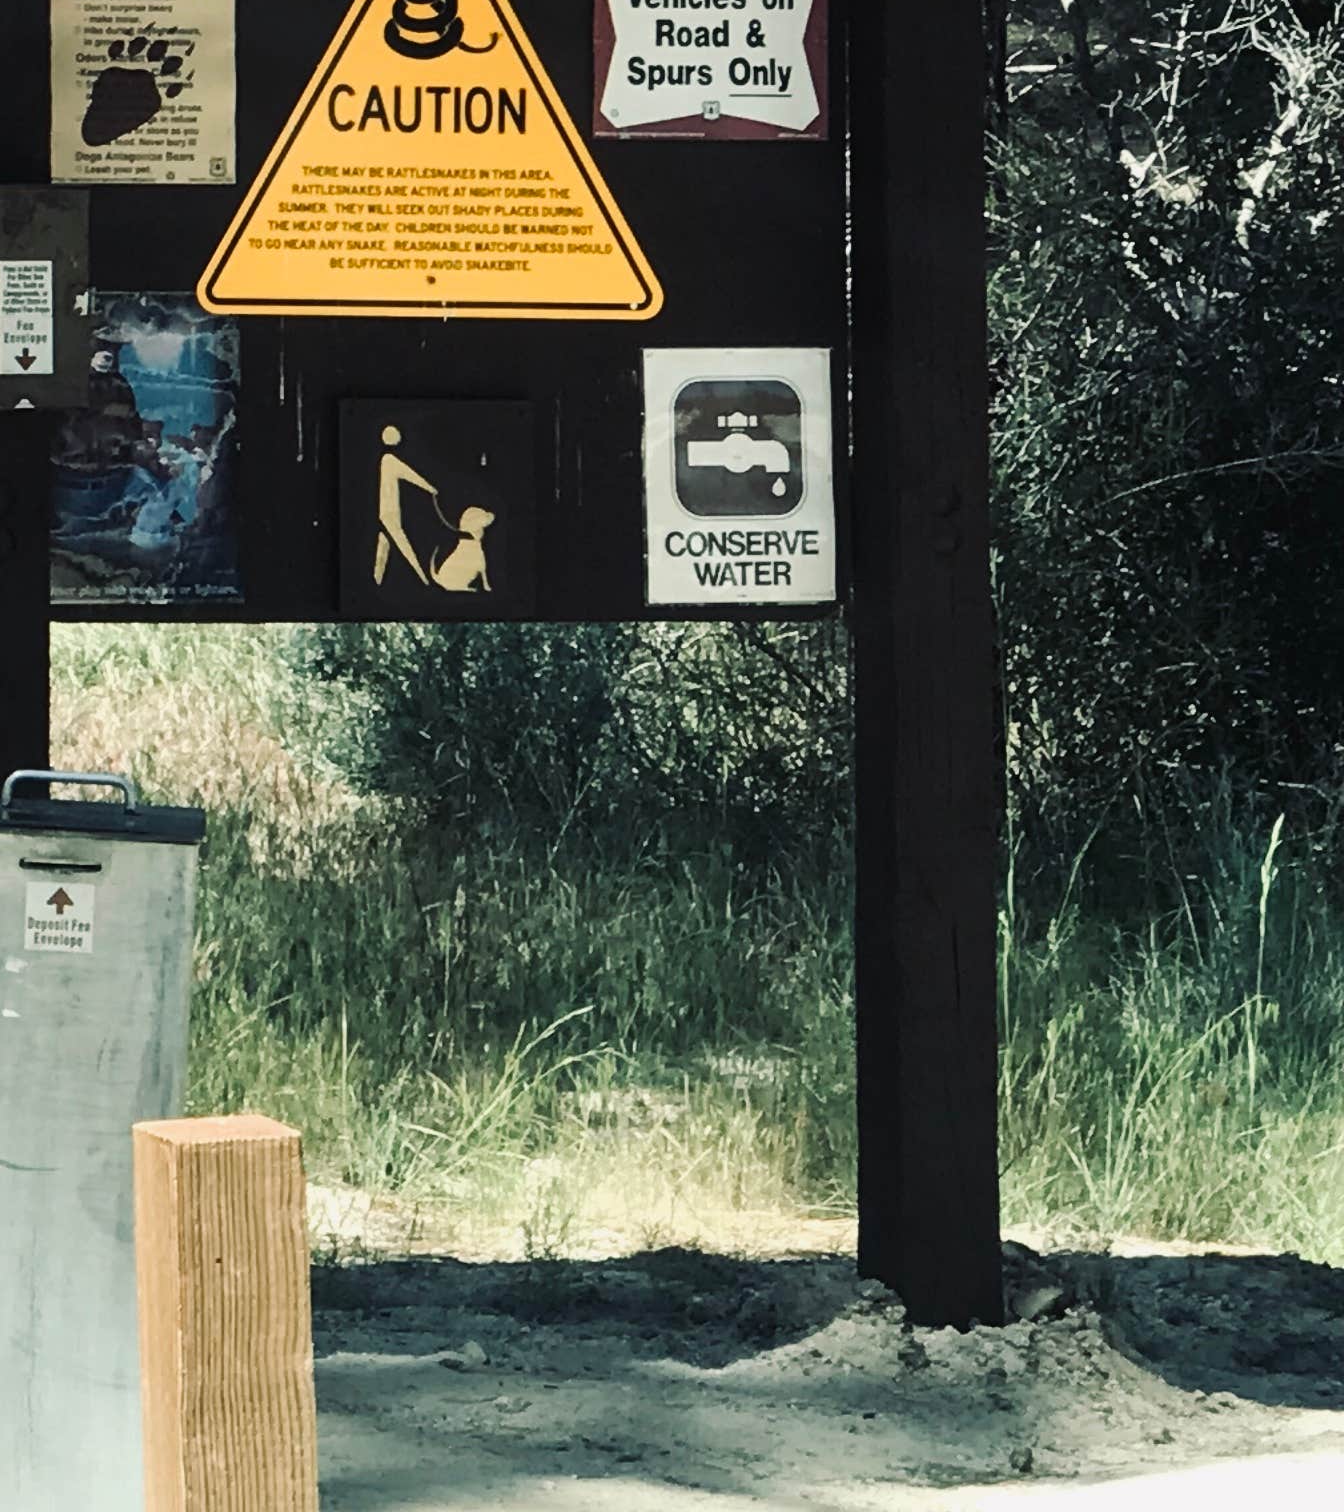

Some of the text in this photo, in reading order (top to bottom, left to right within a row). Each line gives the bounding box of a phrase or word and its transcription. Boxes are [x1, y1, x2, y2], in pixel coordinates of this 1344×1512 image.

[656, 19, 766, 47] Road &
[627, 56, 792, 92] Spurs Only
[328, 84, 526, 134] CAUTION
[302, 166, 338, 177] THERE
[342, 167, 366, 177] MAY
[369, 167, 384, 177] BE
[387, 167, 476, 179] RATTLESNAKES
[479, 170, 489, 179] IN
[493, 169, 516, 179] THIS
[292, 184, 570, 199] RATTLESNAKES ARE ACTIVE AT NIGHT DURING THE
[335, 204, 363, 213] THEY
[368, 204, 393, 214] WILL
[396, 204, 424, 214] SEEK
[428, 205, 450, 216] OUT
[453, 205, 490, 216] SHADY
[494, 206, 539, 217] PLACES
[542, 207, 584, 217] DURING
[268, 220, 289, 230] THE
[293, 220, 321, 231] HEAT
[324, 221, 339, 231] OF
[342, 221, 362, 231] THE
[395, 223, 452, 234] CHILDREN
[454, 224, 499, 234] SHOULD
[504, 224, 517, 234] BE
[521, 225, 568, 235] WARNED
[572, 225, 593, 235] NOT
[249, 239, 262, 249] TO
[265, 239, 280, 249] GO
[284, 239, 315, 249] NEAR
[319, 240, 343, 250] ANY
[394, 241, 472, 252] REASONABLE
[475, 242, 563, 253] WATCHFULNESS
[567, 243, 612, 254] SHOULD
[330, 258, 344, 268] BE
[348, 258, 411, 269] SUFFICIENT
[414, 259, 427, 269] TO
[17, 321, 34, 330] Fee
[4, 333, 47, 344] Envelope
[665, 530, 819, 557] CONSERVE
[694, 562, 791, 586] WATER
[28, 917, 91, 932] Deposit Fee
[33, 933, 83, 947] Envelope
